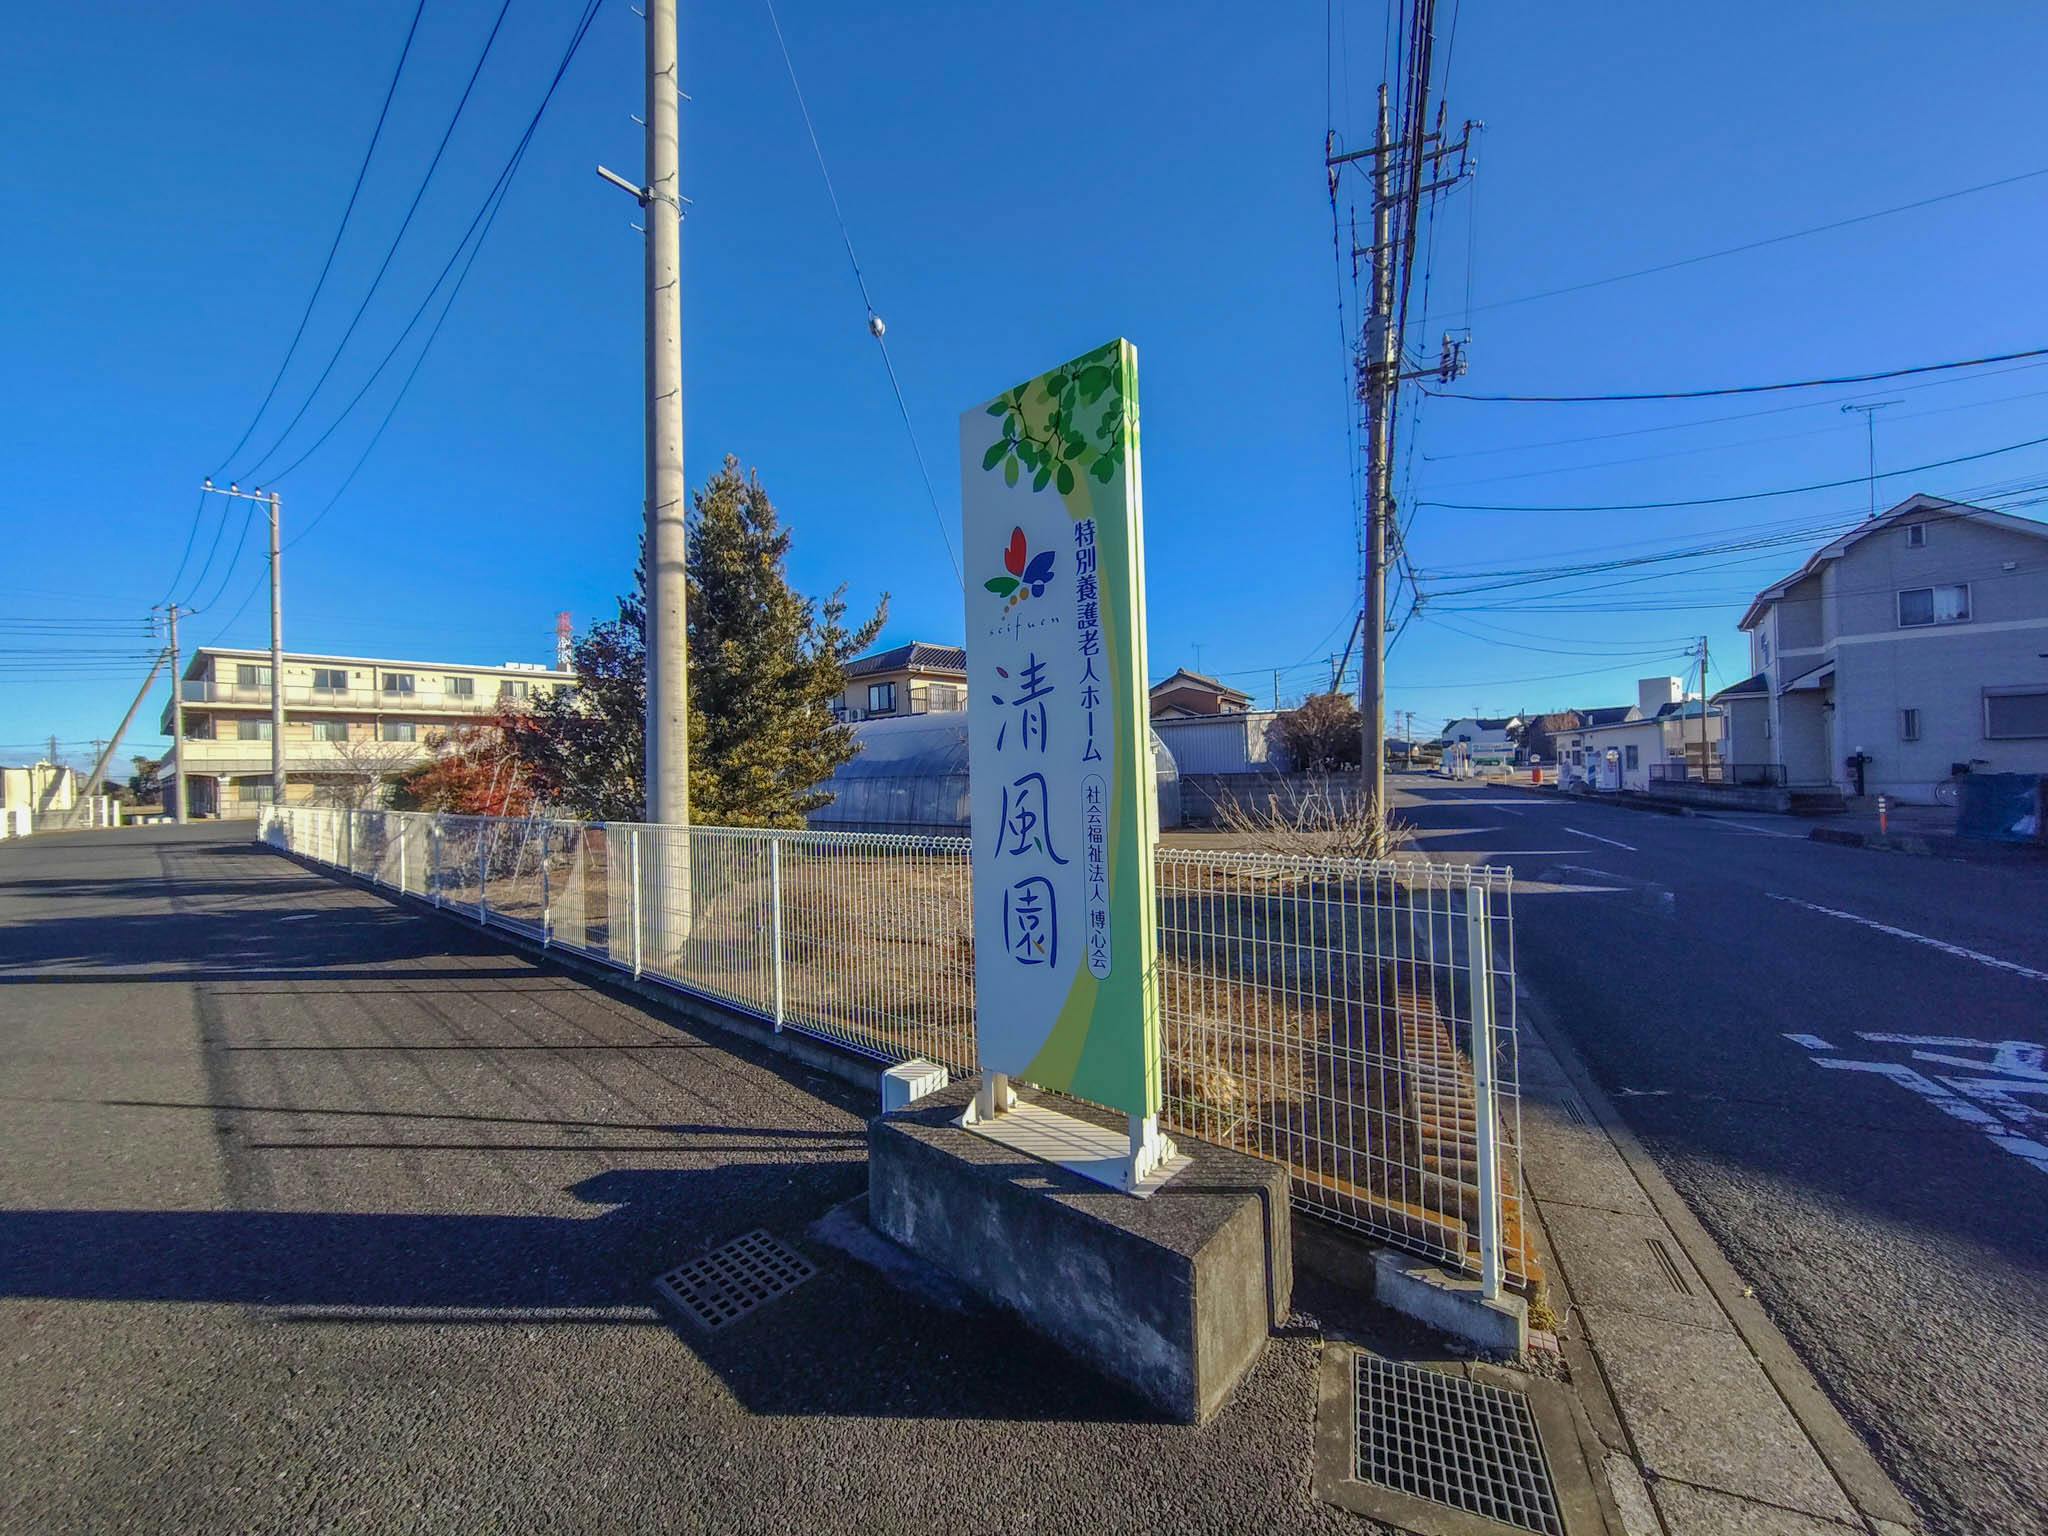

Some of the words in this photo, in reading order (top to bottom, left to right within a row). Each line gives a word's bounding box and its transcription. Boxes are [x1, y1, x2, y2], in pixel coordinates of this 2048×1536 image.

[1074, 518, 1102, 763] 特別養護老人ホーム
[991, 652, 1069, 969] 清風園
[1085, 785, 1105, 903] 社会福祉法人
[1090, 909, 1107, 969] 博心会
